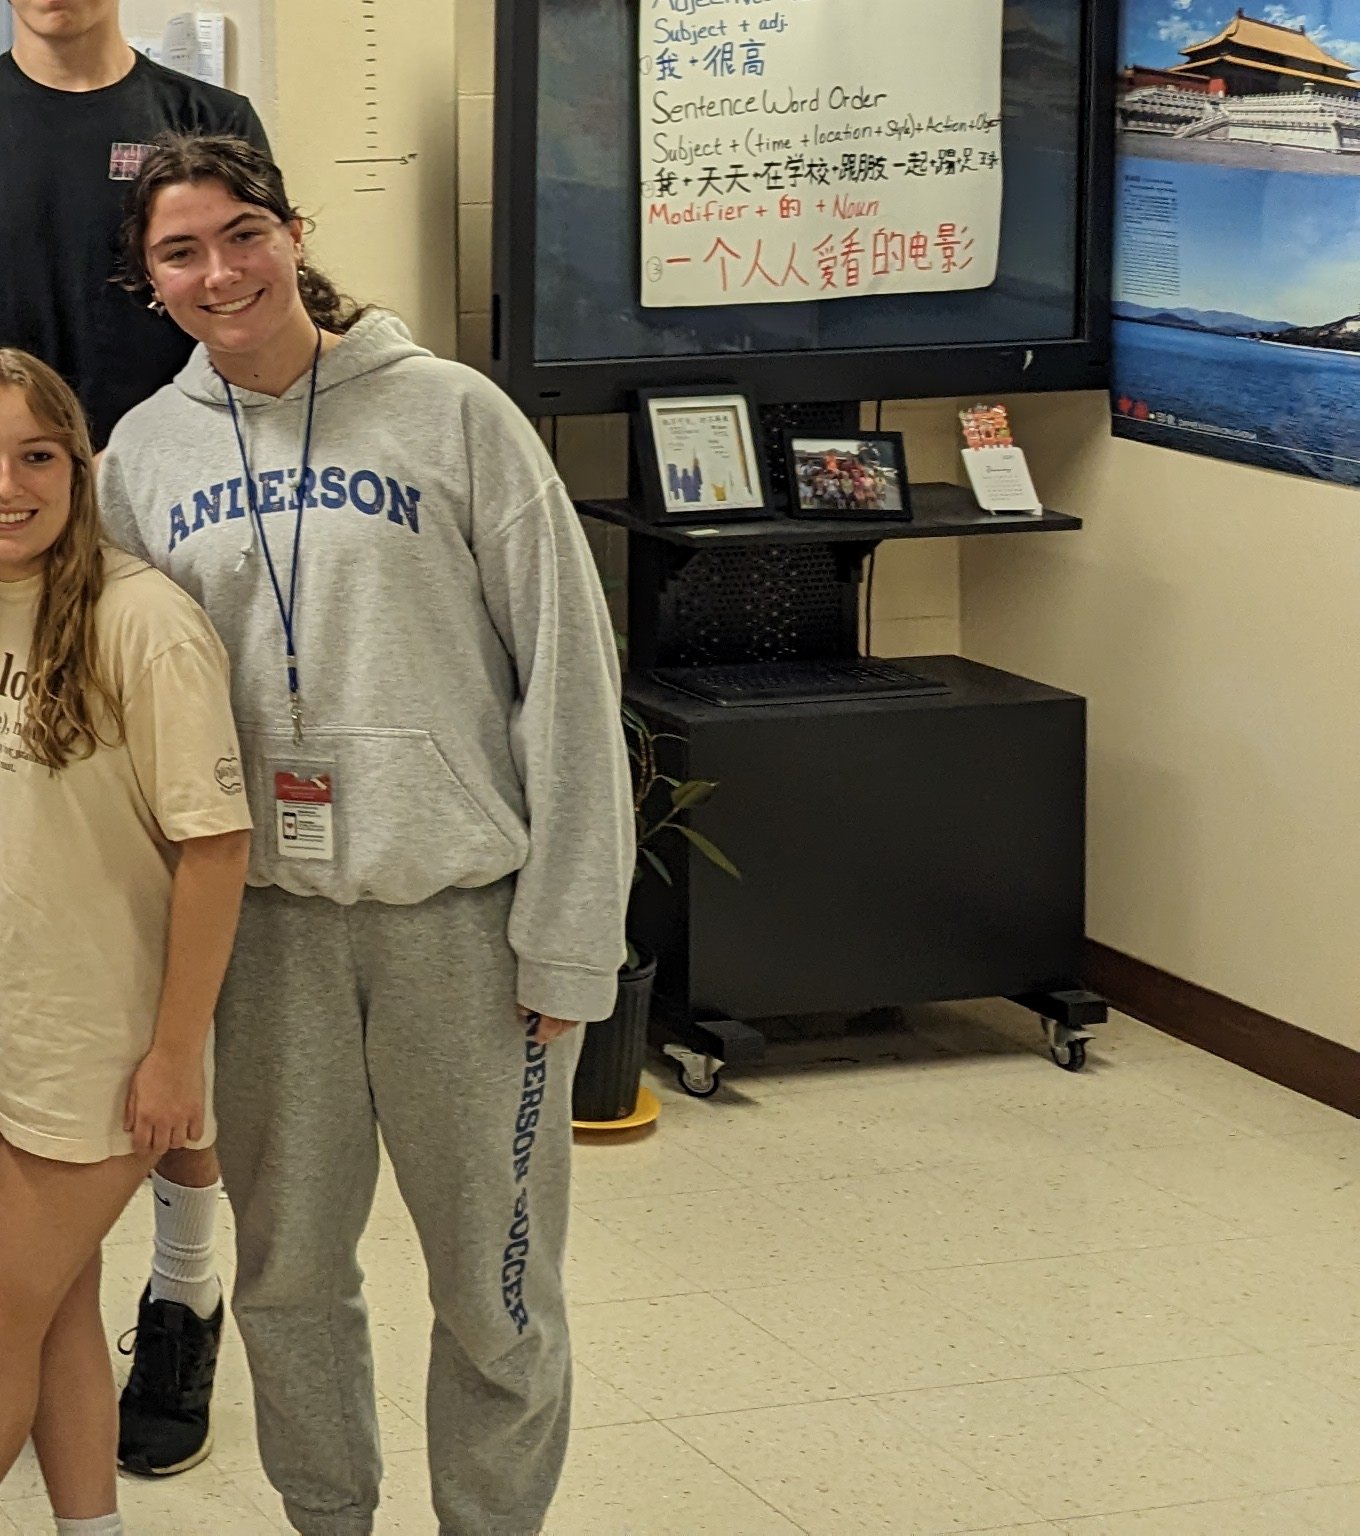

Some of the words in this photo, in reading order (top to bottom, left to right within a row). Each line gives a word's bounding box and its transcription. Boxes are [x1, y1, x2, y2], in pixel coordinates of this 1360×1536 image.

[653, 18, 727, 45] Subject
[652, 90, 758, 124] Sentence
[762, 86, 820, 114] Word
[829, 86, 887, 110] Order
[651, 132, 722, 165] Subject
[648, 200, 749, 225] Modifier
[168, 466, 421, 553] ANDERSON
